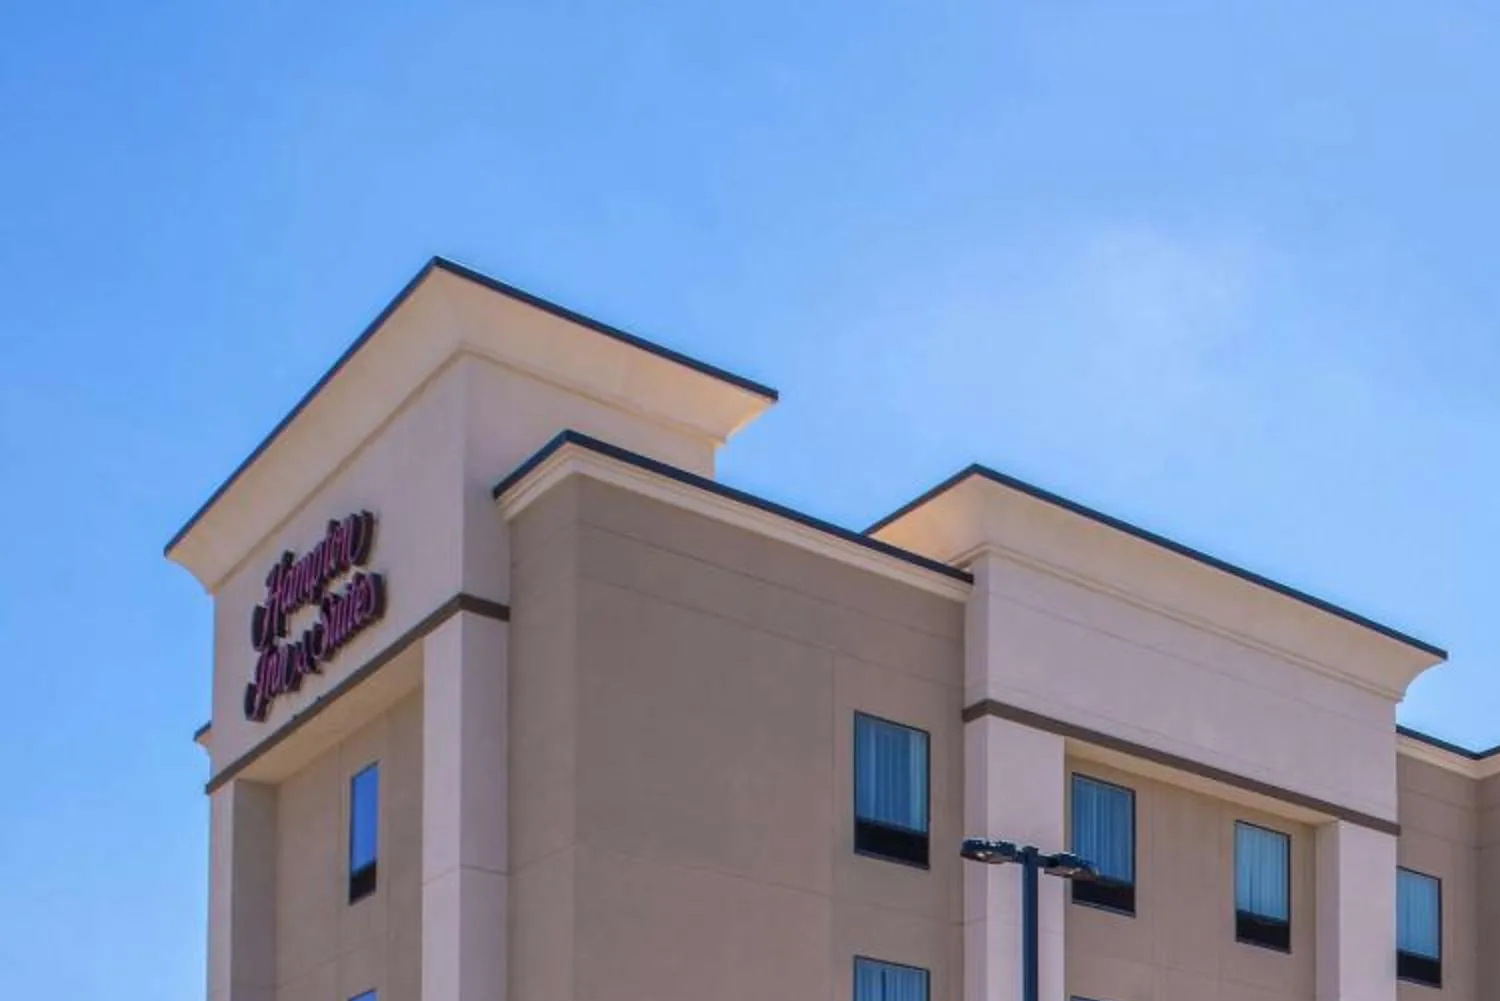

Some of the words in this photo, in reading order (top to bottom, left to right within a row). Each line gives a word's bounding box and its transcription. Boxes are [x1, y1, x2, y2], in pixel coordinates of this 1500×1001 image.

[244, 645, 303, 722] Inn
[311, 572, 387, 662] Suites
[252, 510, 375, 652] Hampton
